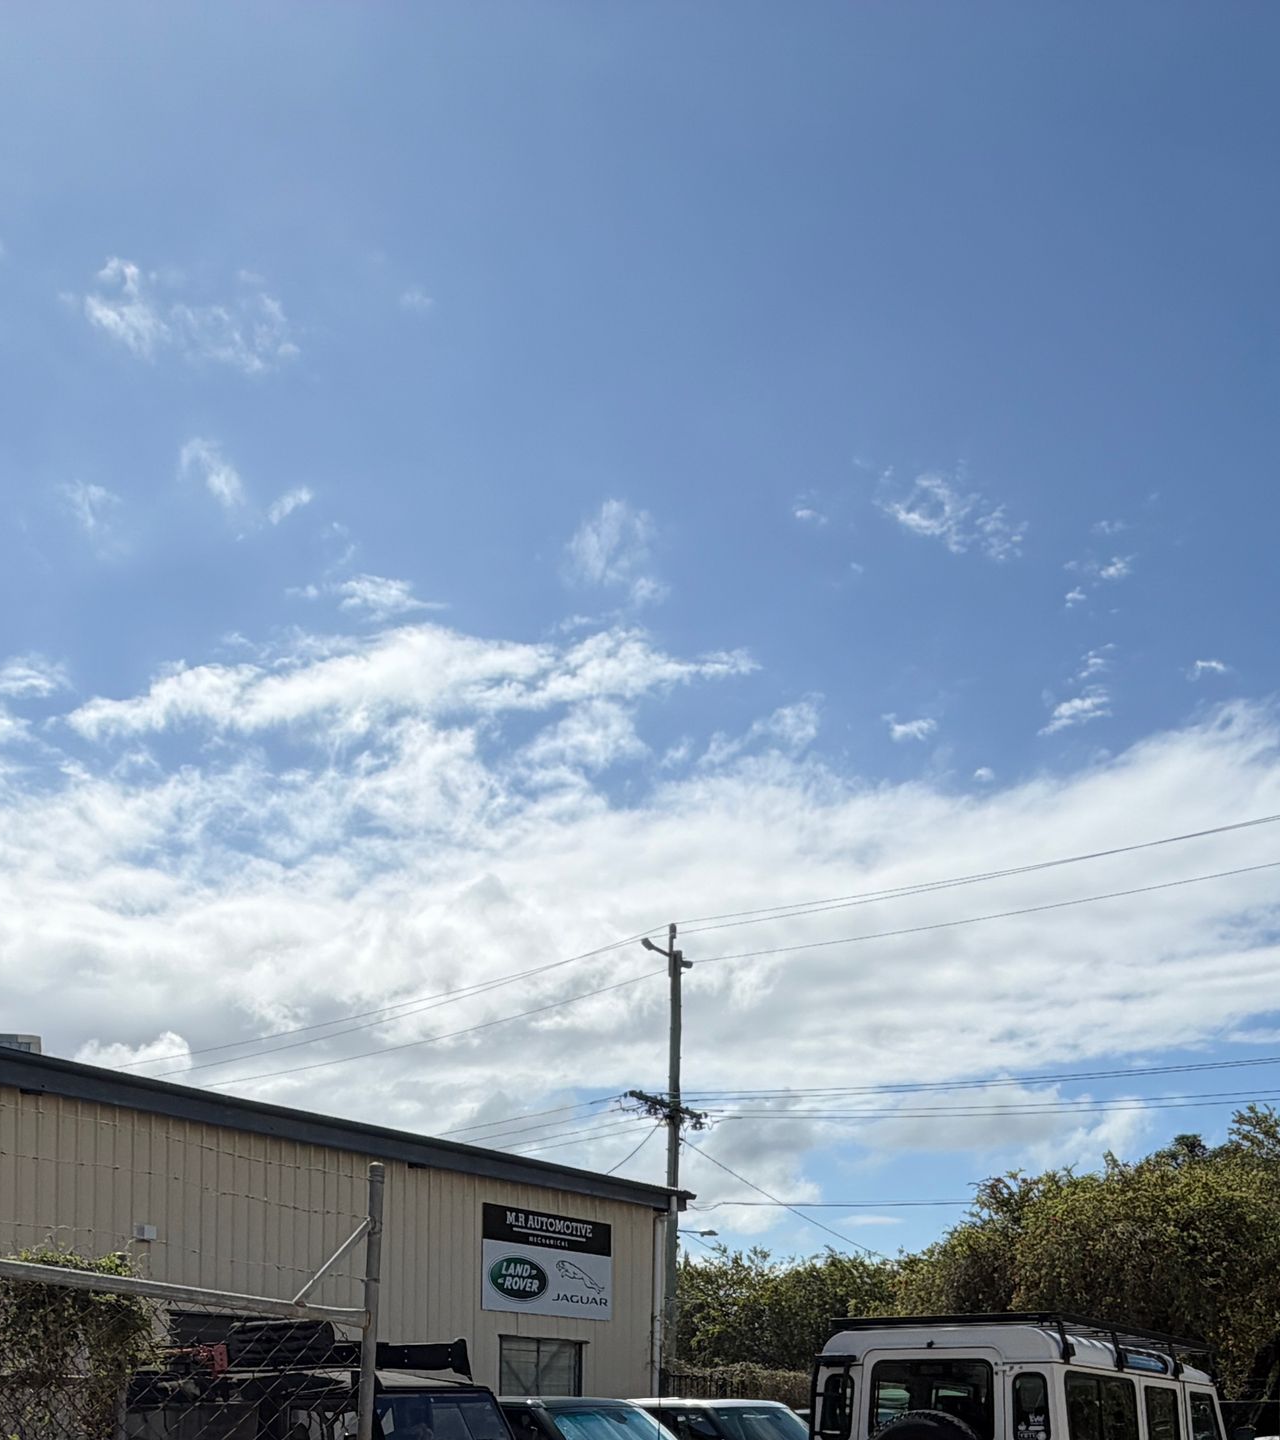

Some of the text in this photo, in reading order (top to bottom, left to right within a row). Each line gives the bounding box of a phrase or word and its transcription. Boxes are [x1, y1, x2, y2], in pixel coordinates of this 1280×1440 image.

[527, 1215, 593, 1238] AUTOMOTIVE
[501, 1262, 531, 1277] LAND
[503, 1276, 540, 1293] ROVER
[551, 1293, 609, 1307] JAGUAR
